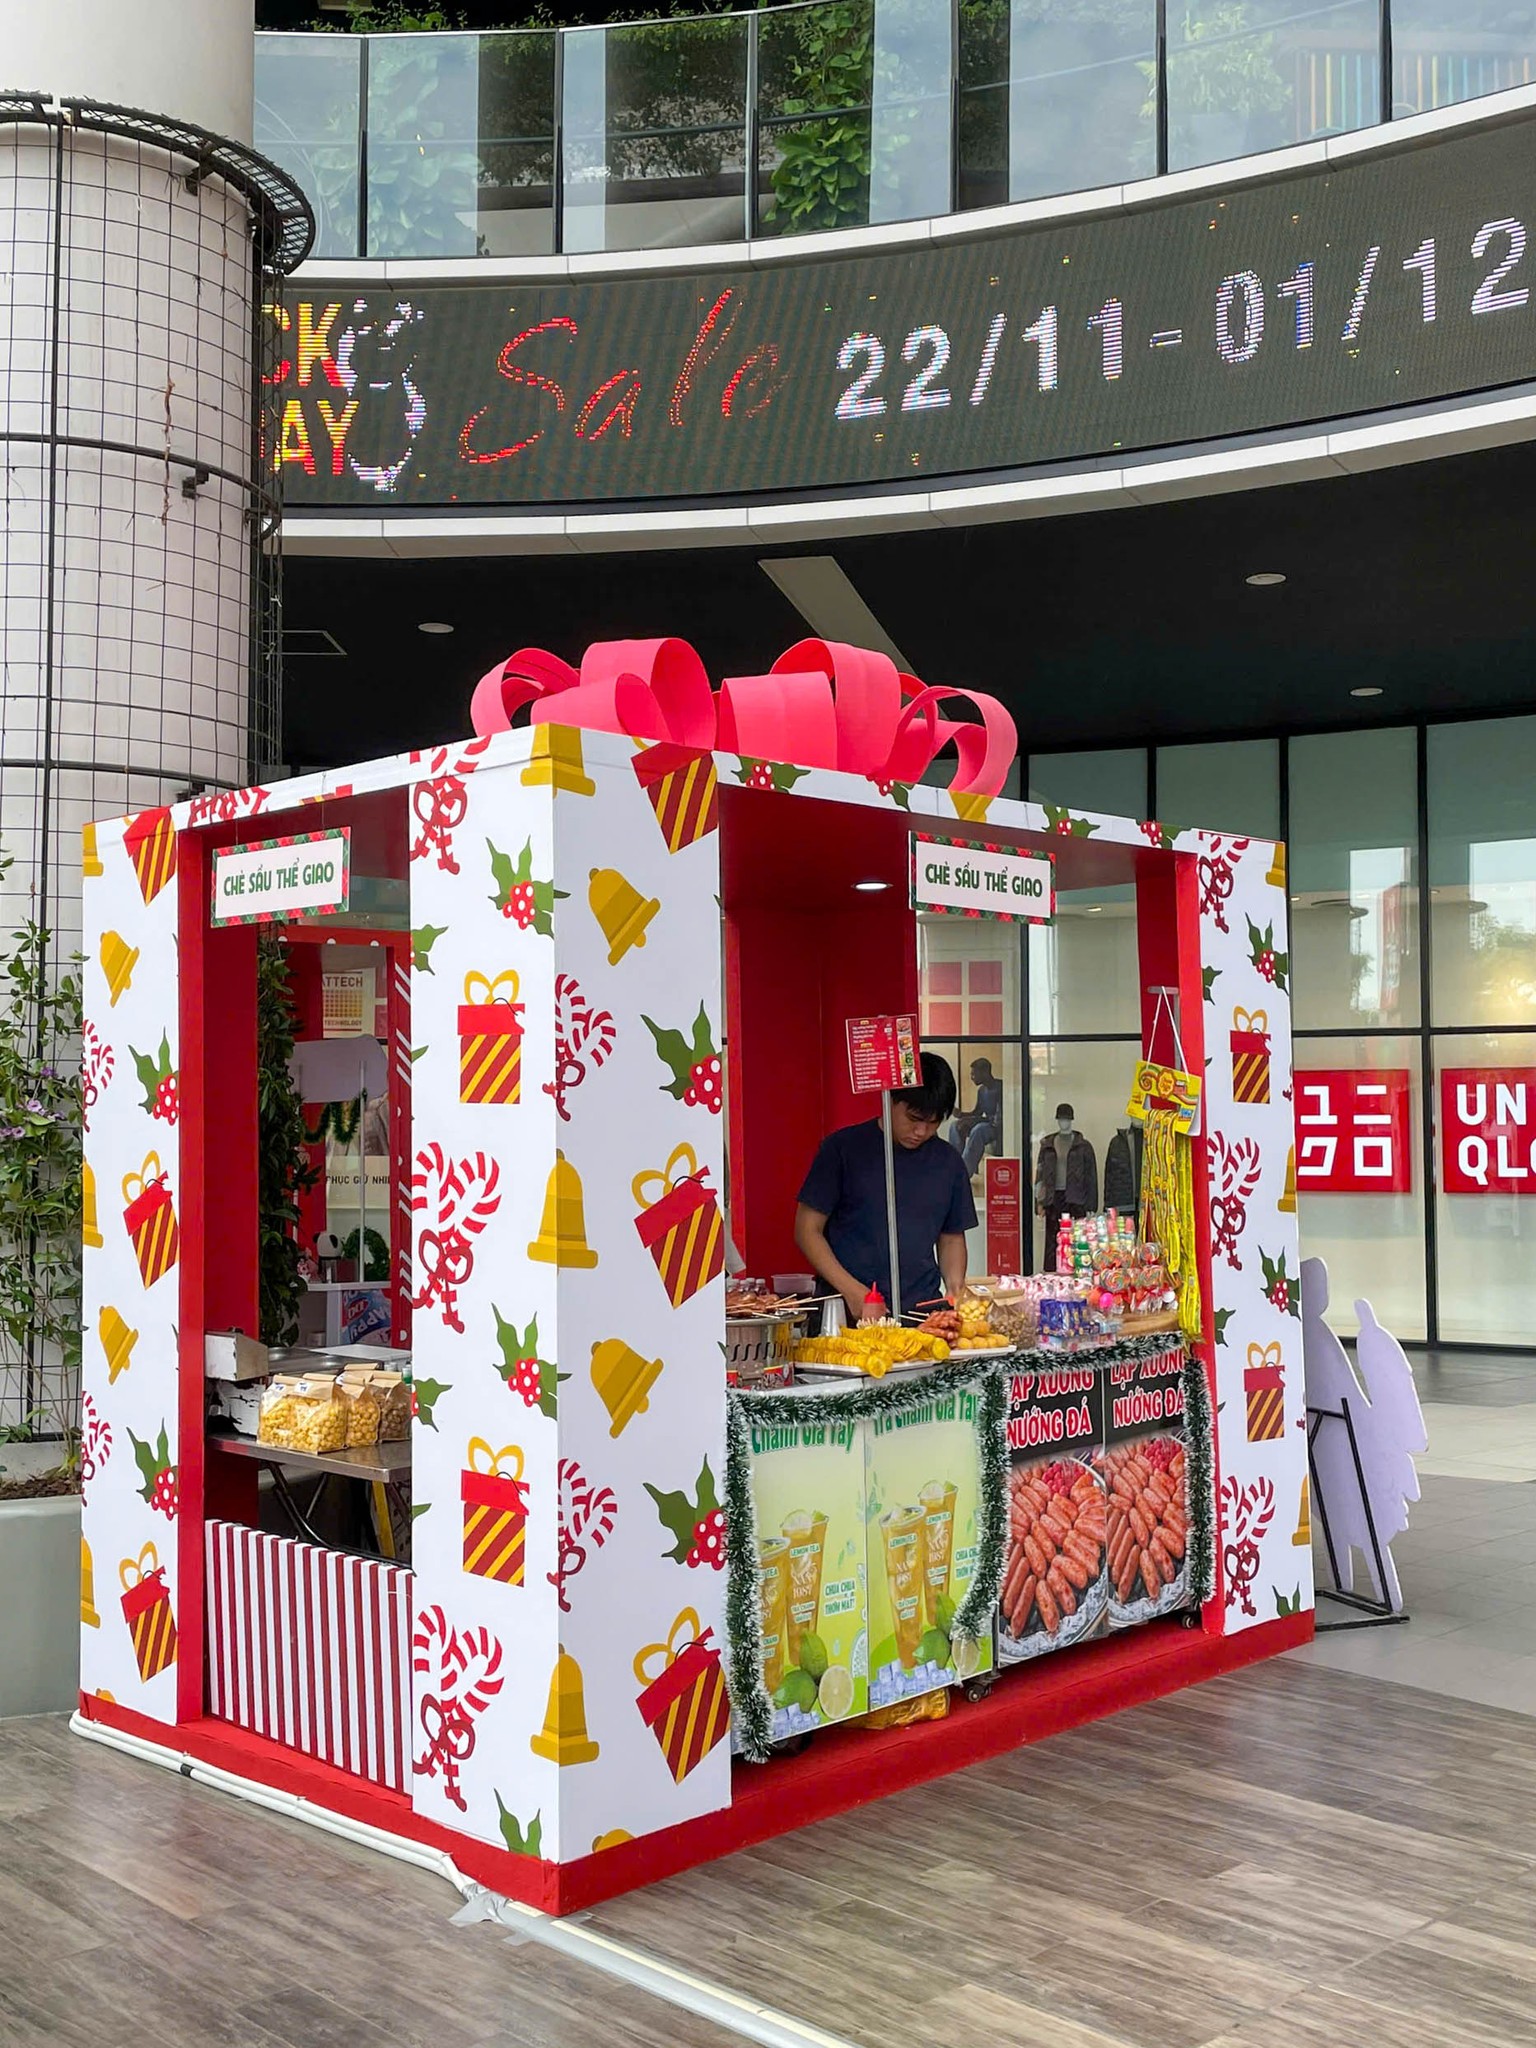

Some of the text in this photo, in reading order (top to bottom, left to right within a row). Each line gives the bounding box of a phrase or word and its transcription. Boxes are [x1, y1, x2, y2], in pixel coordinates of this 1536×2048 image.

[459, 287, 788, 463] Sale
[261, 399, 360, 475] AY
[223, 869, 245, 897] CHÈ
[302, 861, 334, 886] GIAO
[925, 861, 950, 886] CHÈ
[1012, 875, 1043, 898] GIAO
[1456, 1083, 1527, 1126] UN
[1457, 1135, 1536, 1186] QL
[1065, 1395, 1093, 1437] ĐÁ
[1113, 1384, 1162, 1430] NƯỚNG
[809, 1544, 819, 1552] TEA
